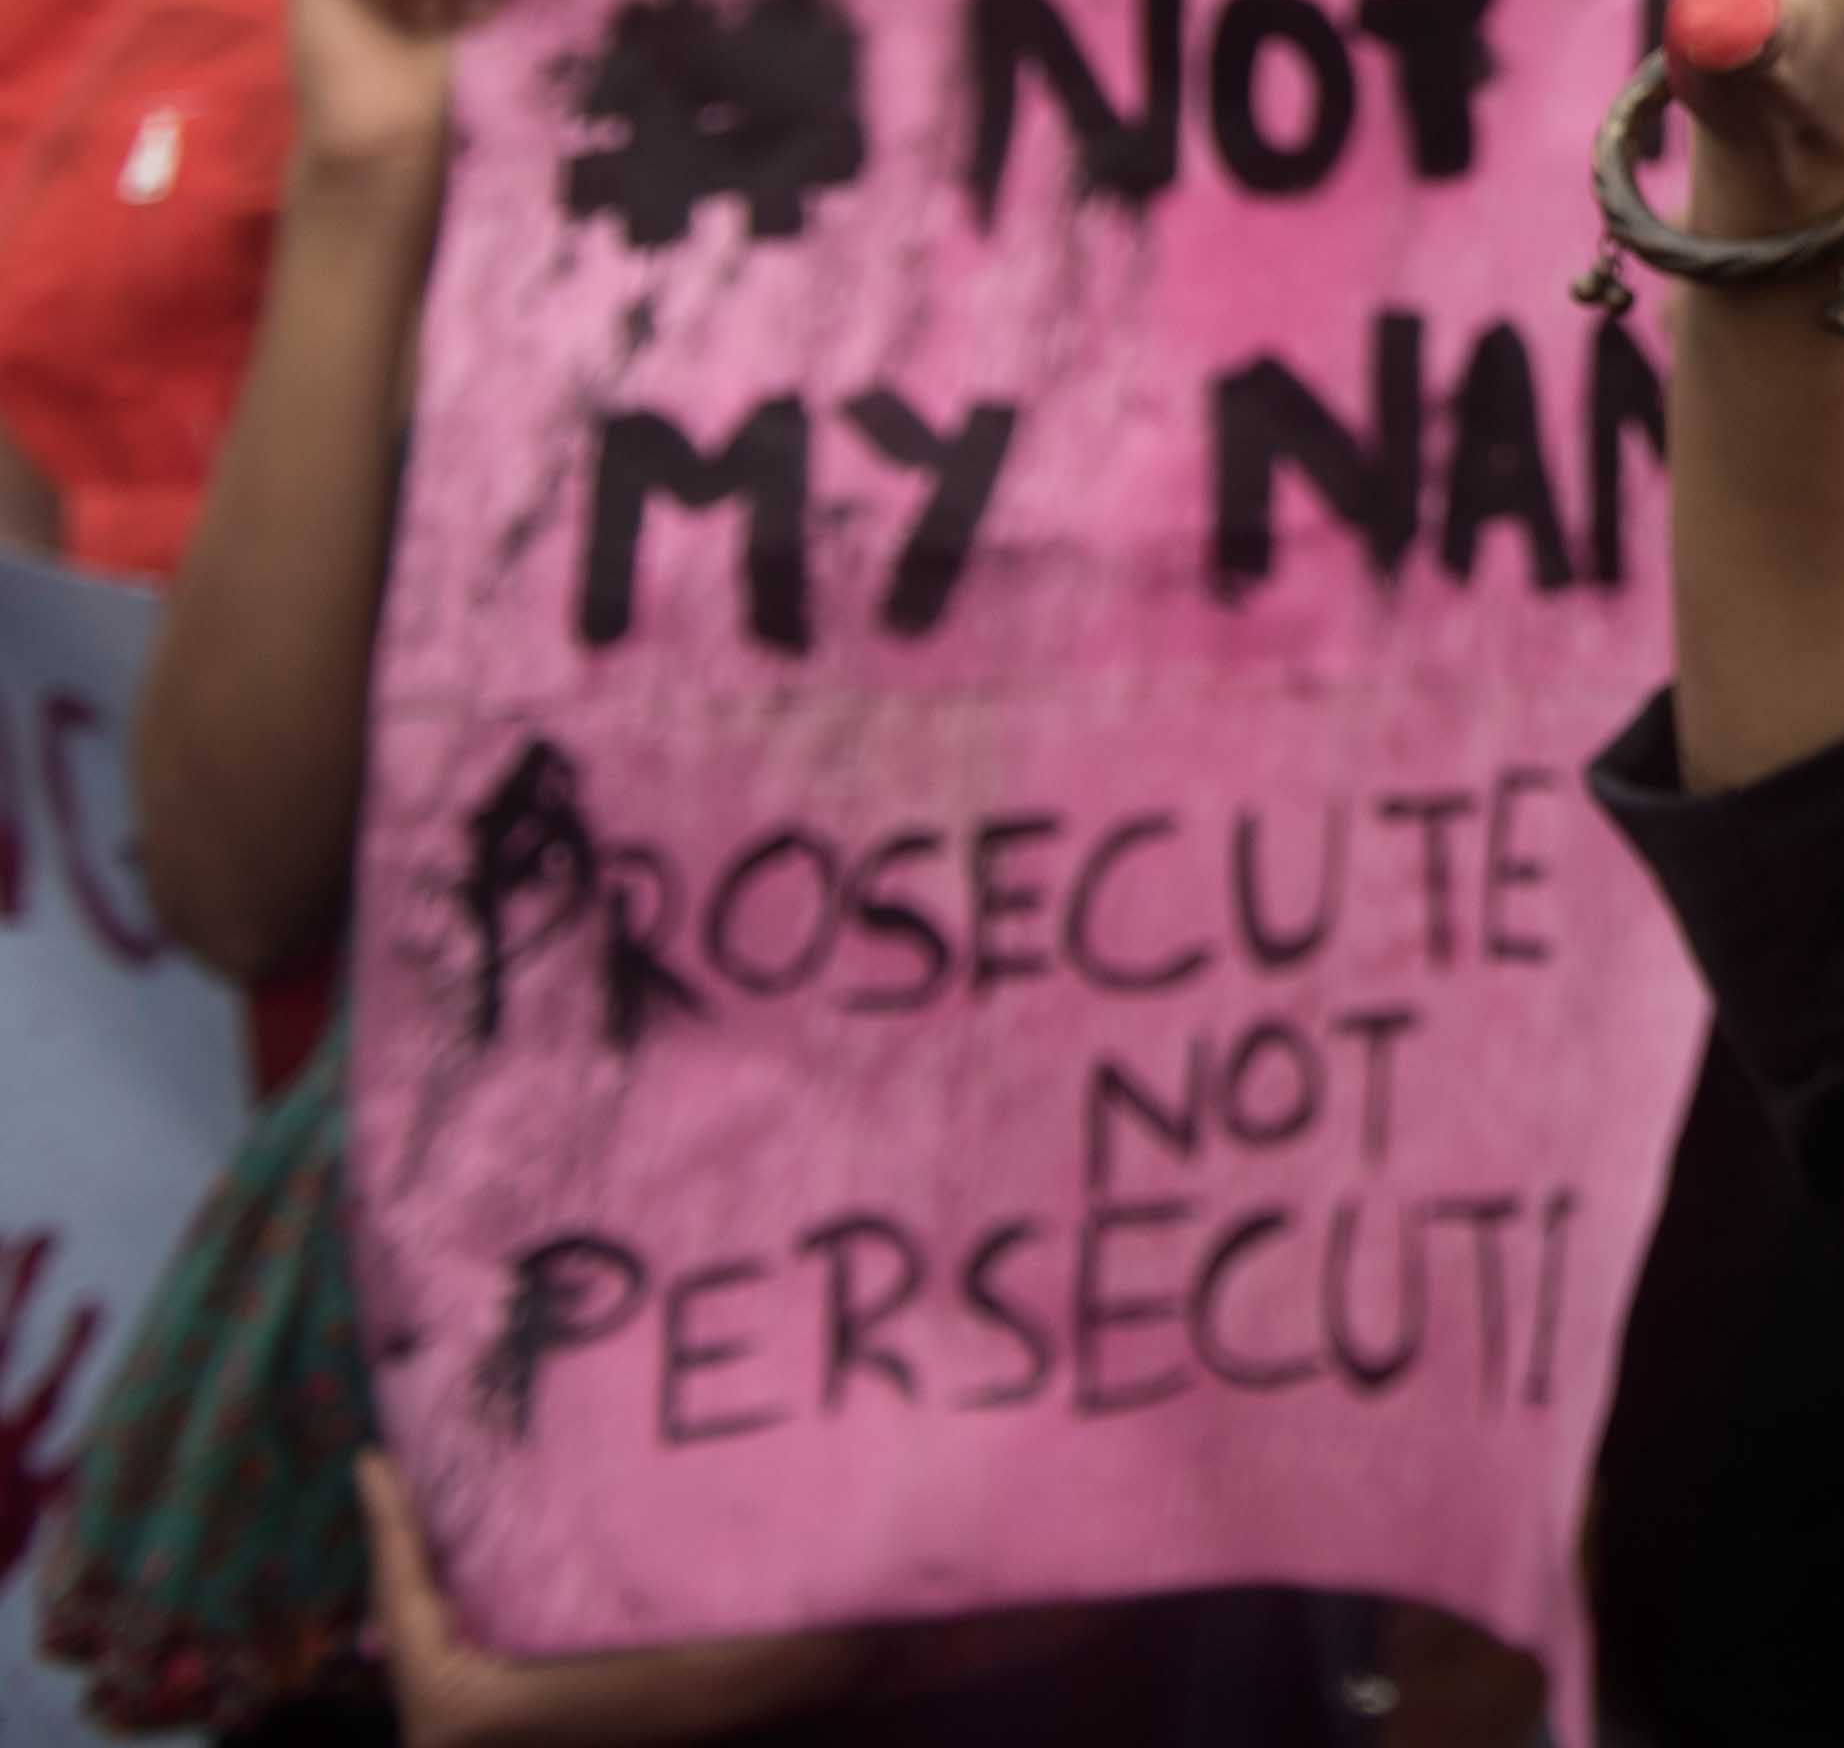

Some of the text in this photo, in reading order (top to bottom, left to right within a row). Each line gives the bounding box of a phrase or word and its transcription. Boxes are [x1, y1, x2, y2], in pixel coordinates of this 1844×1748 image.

[574, 388, 1020, 652] MY
[464, 734, 1556, 1050] PROSECUTE
[1086, 1006, 1420, 1186] NOT
